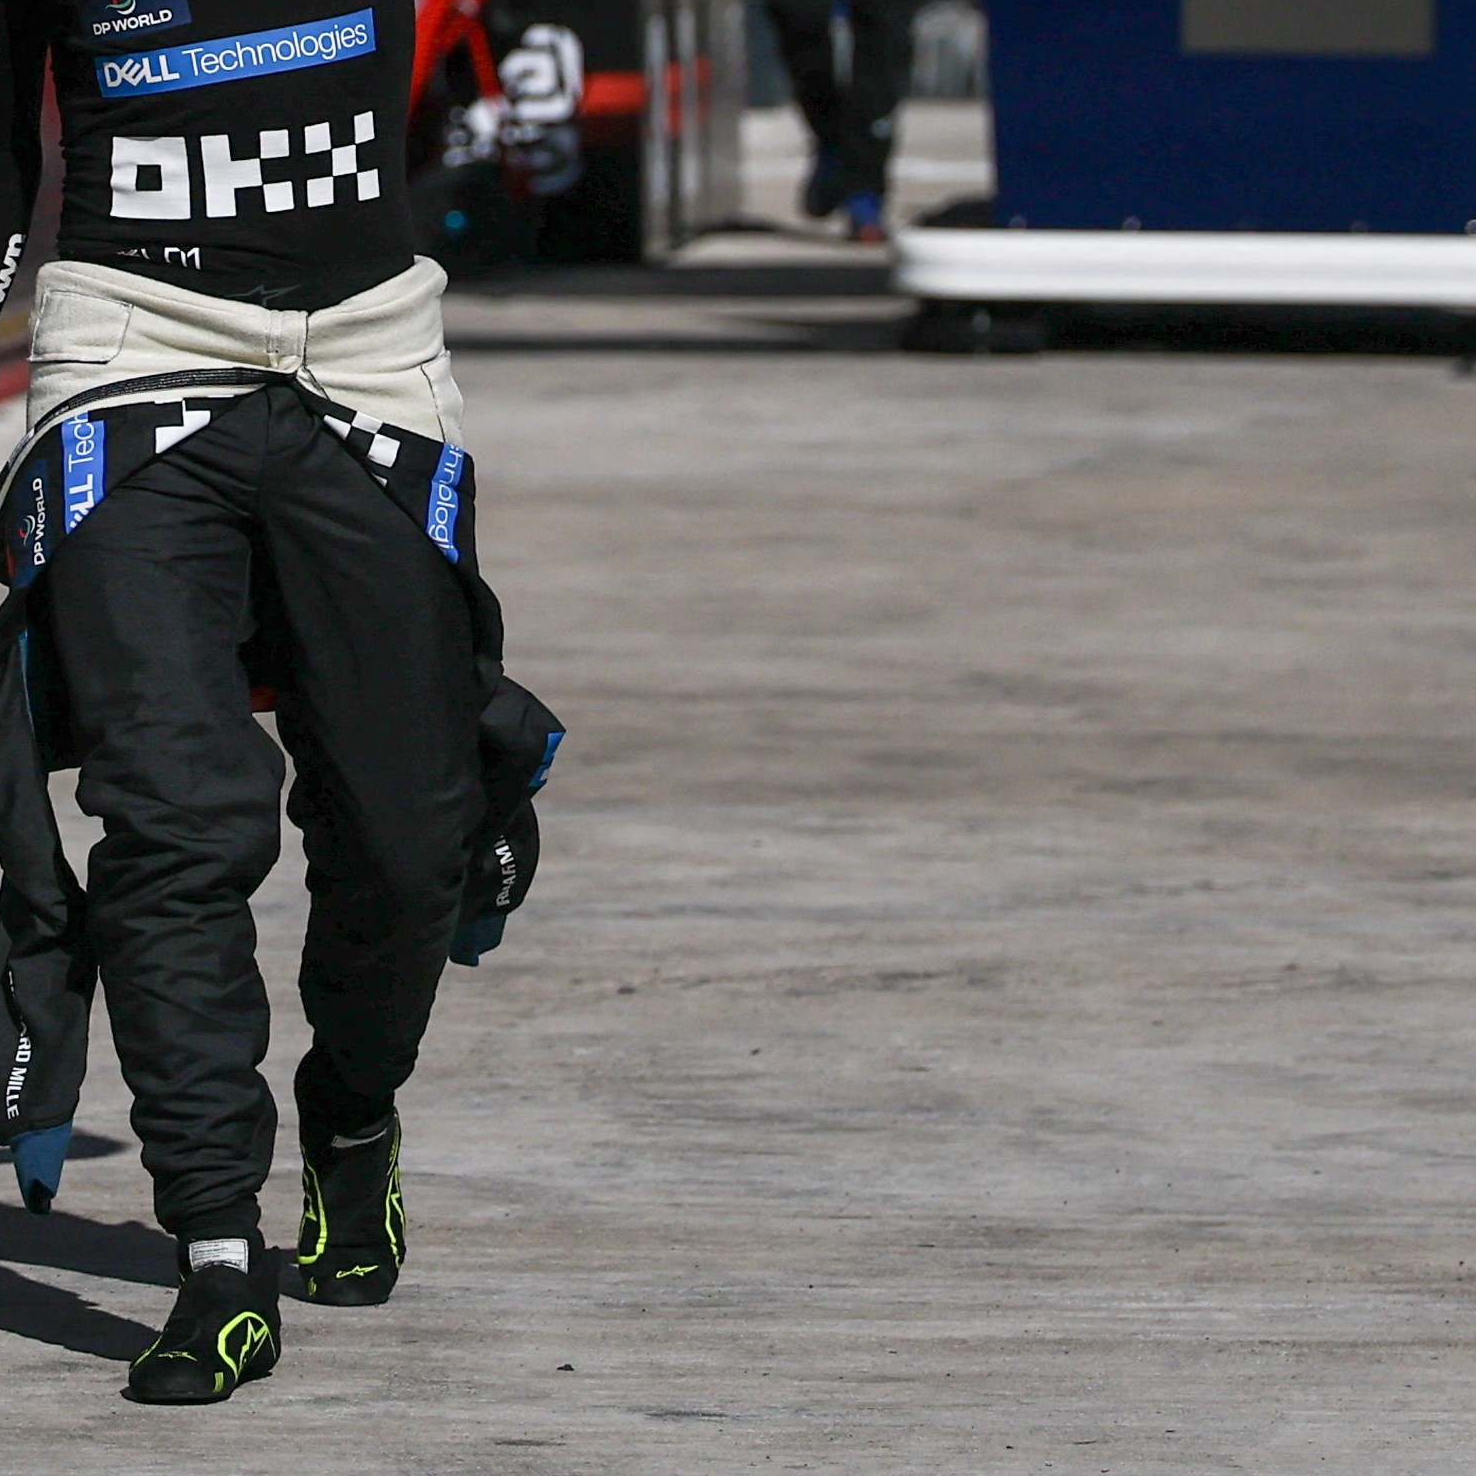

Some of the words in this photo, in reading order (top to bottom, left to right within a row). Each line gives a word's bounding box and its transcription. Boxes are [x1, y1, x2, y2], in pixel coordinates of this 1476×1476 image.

[92, 21, 112, 36] DP
[111, 9, 173, 33] WORLD
[103, 54, 181, 89] DELL
[181, 23, 368, 77] Technologies
[109, 110, 381, 221] OKX
[32, 477, 46, 541] WORLD
[33, 544, 47, 566] DP
[6, 1066, 27, 1121] MILLE
